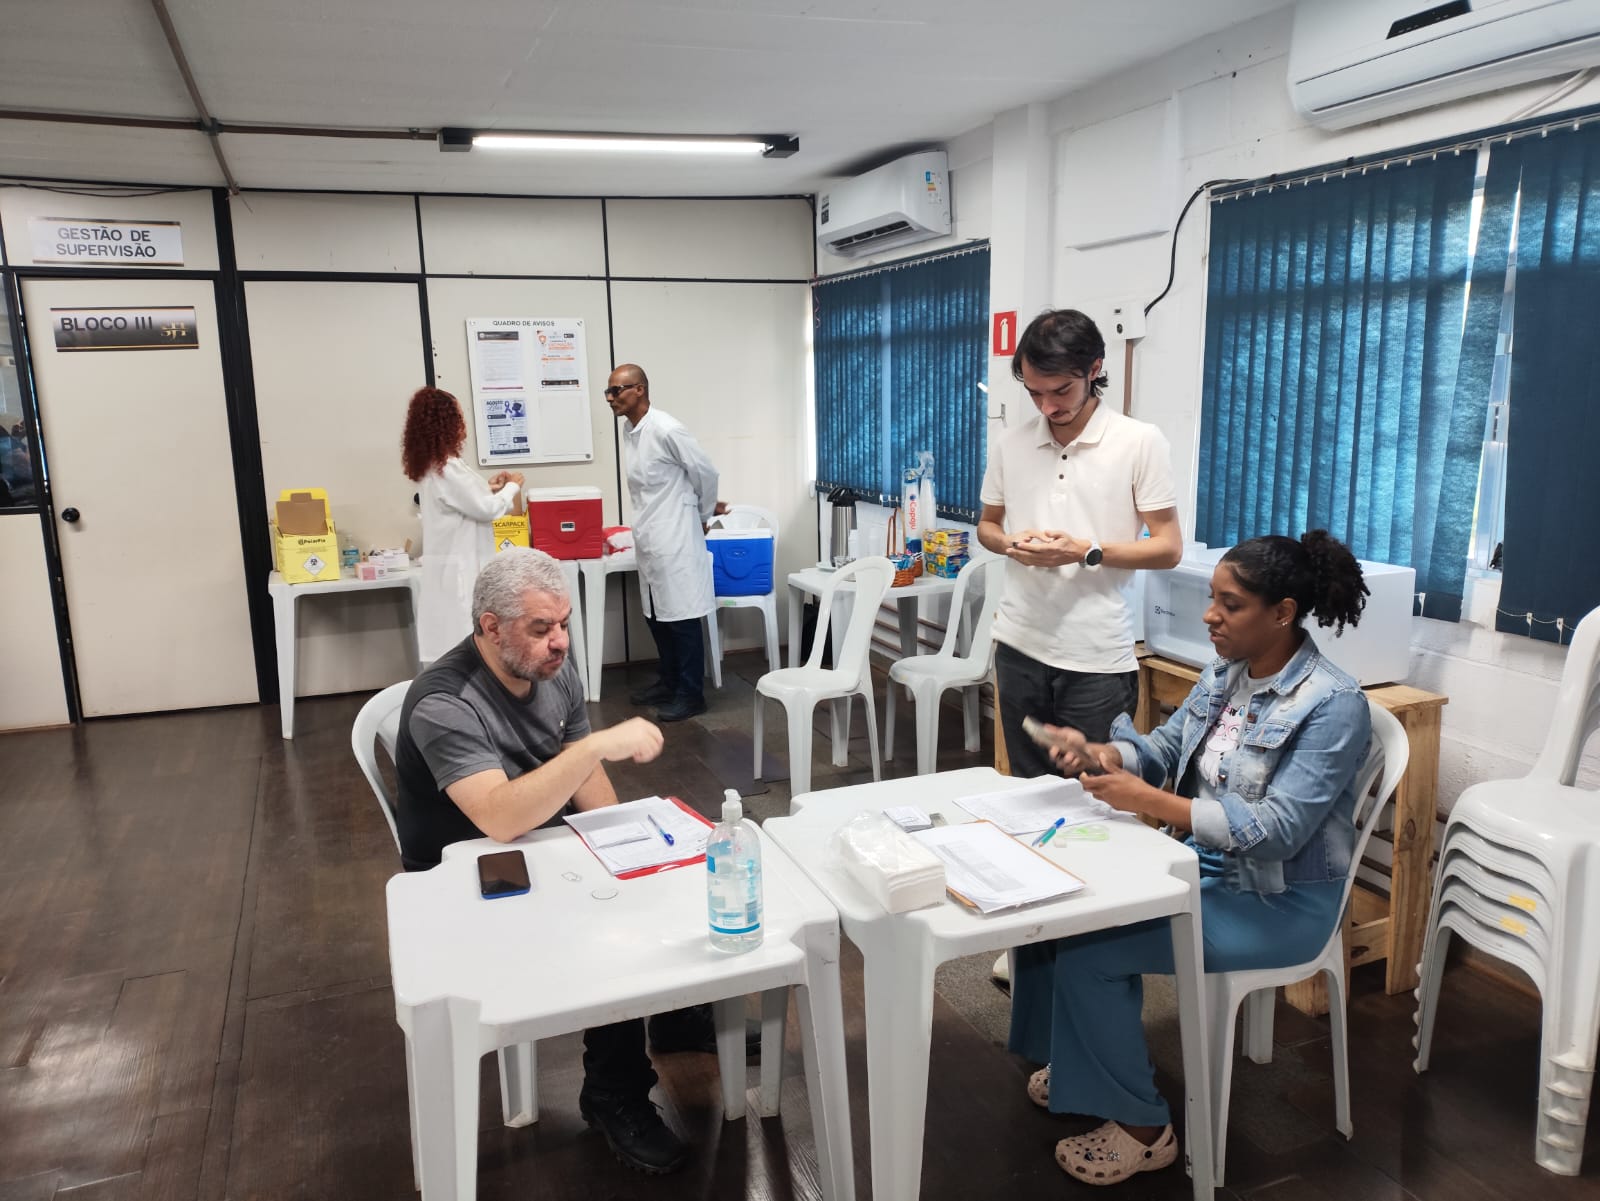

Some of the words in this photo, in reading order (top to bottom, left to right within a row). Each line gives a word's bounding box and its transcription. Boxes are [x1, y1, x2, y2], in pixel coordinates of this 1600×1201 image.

[57, 225, 123, 241] GESTÃO
[130, 229, 151, 242] DE
[56, 242, 157, 258] SUPERVISÃO
[60, 316, 128, 332] BLOCO
[135, 316, 153, 330] III
